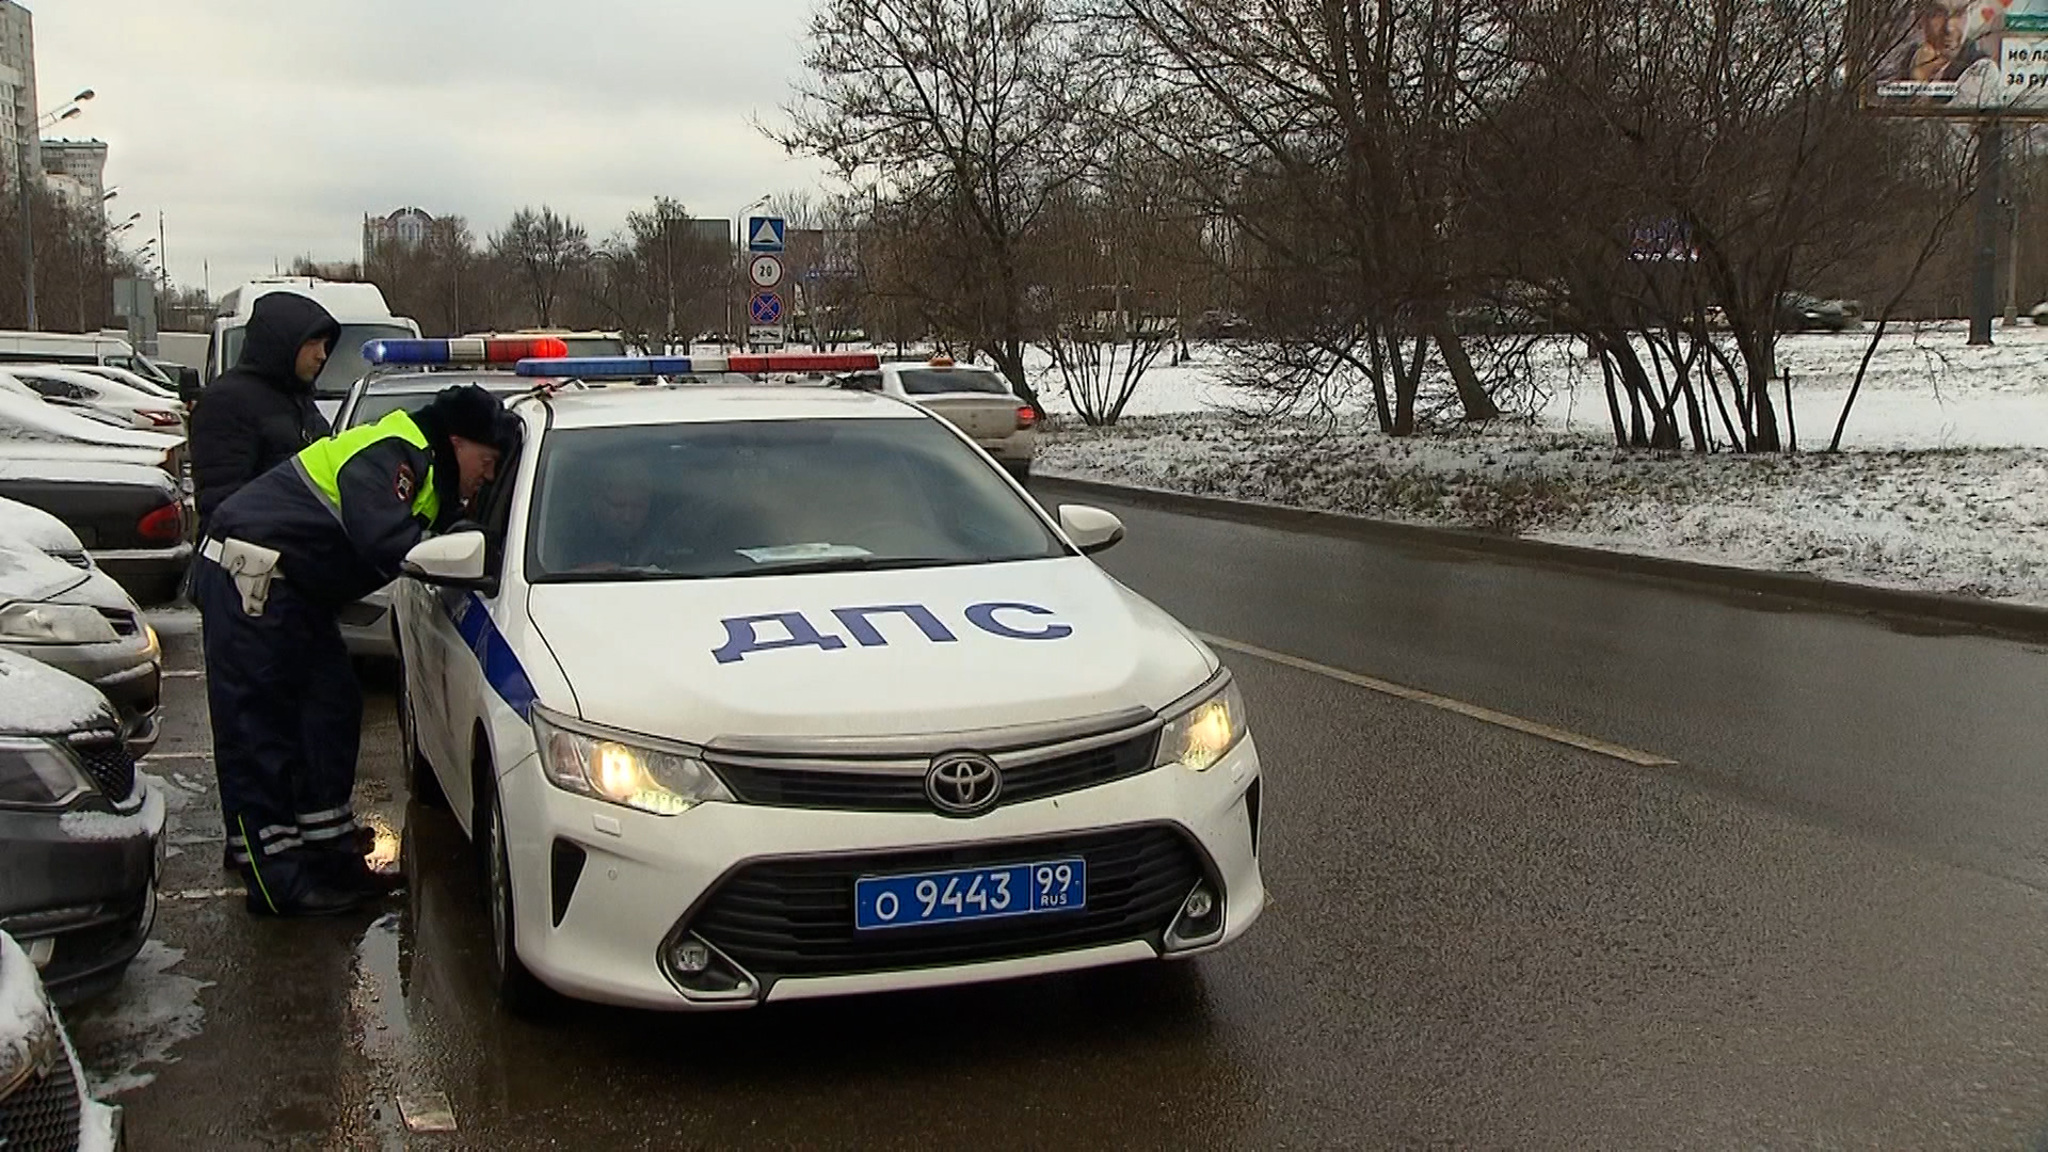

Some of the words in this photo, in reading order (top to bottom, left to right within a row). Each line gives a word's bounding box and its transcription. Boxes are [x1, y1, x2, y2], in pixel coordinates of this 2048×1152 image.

[759, 265, 772, 277] 20
[711, 602, 1072, 664] ДПС
[1037, 865, 1072, 894] 99
[916, 872, 1011, 917] 9443
[1040, 894, 1068, 906] RUS
